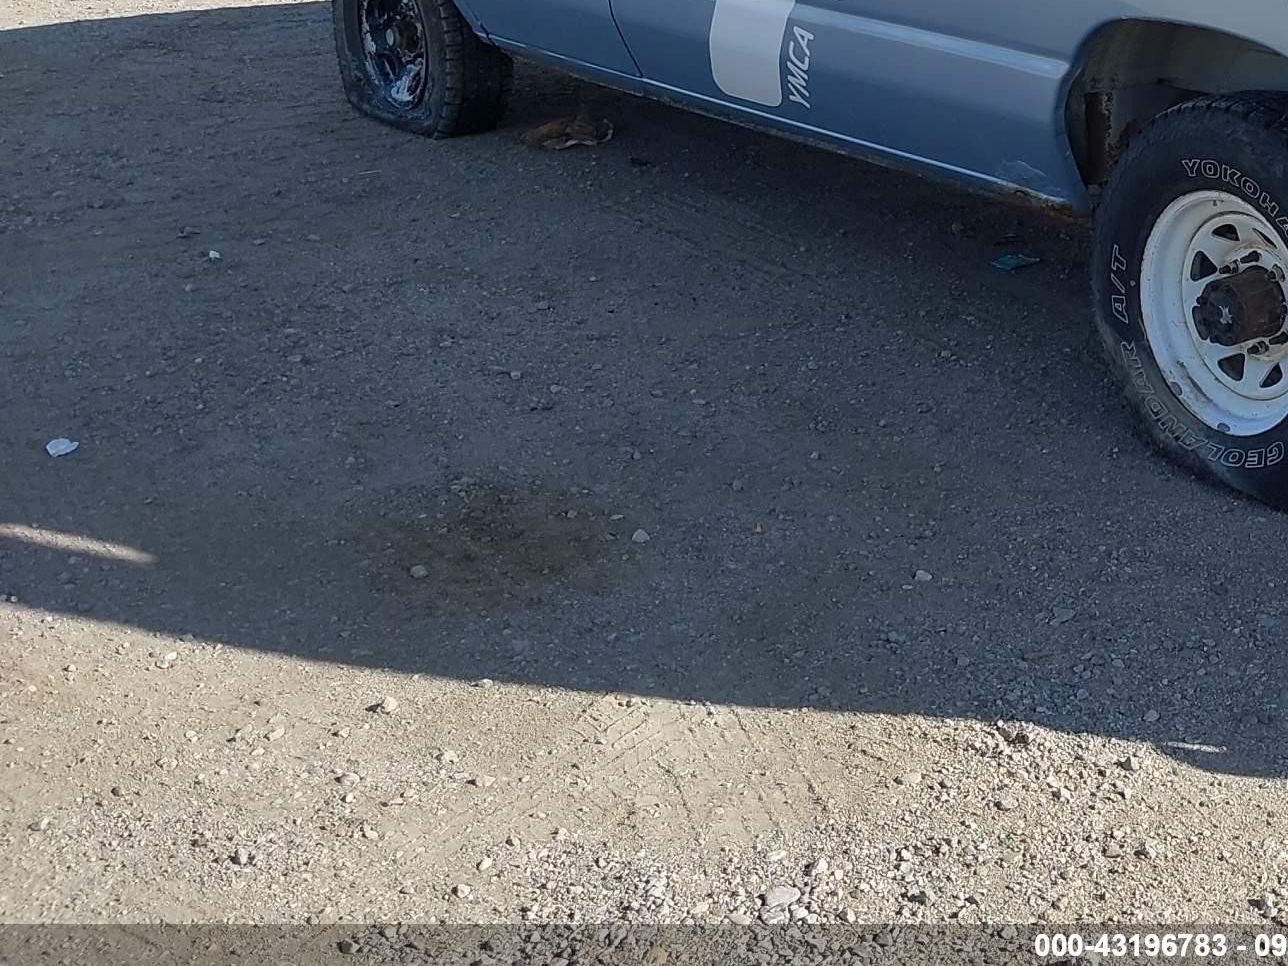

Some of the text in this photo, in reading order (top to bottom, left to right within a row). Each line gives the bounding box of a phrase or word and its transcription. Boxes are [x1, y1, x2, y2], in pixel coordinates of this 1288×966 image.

[789, 25, 814, 109] YMCA
[1111, 244, 1285, 469] GEOLANDAR A/T
